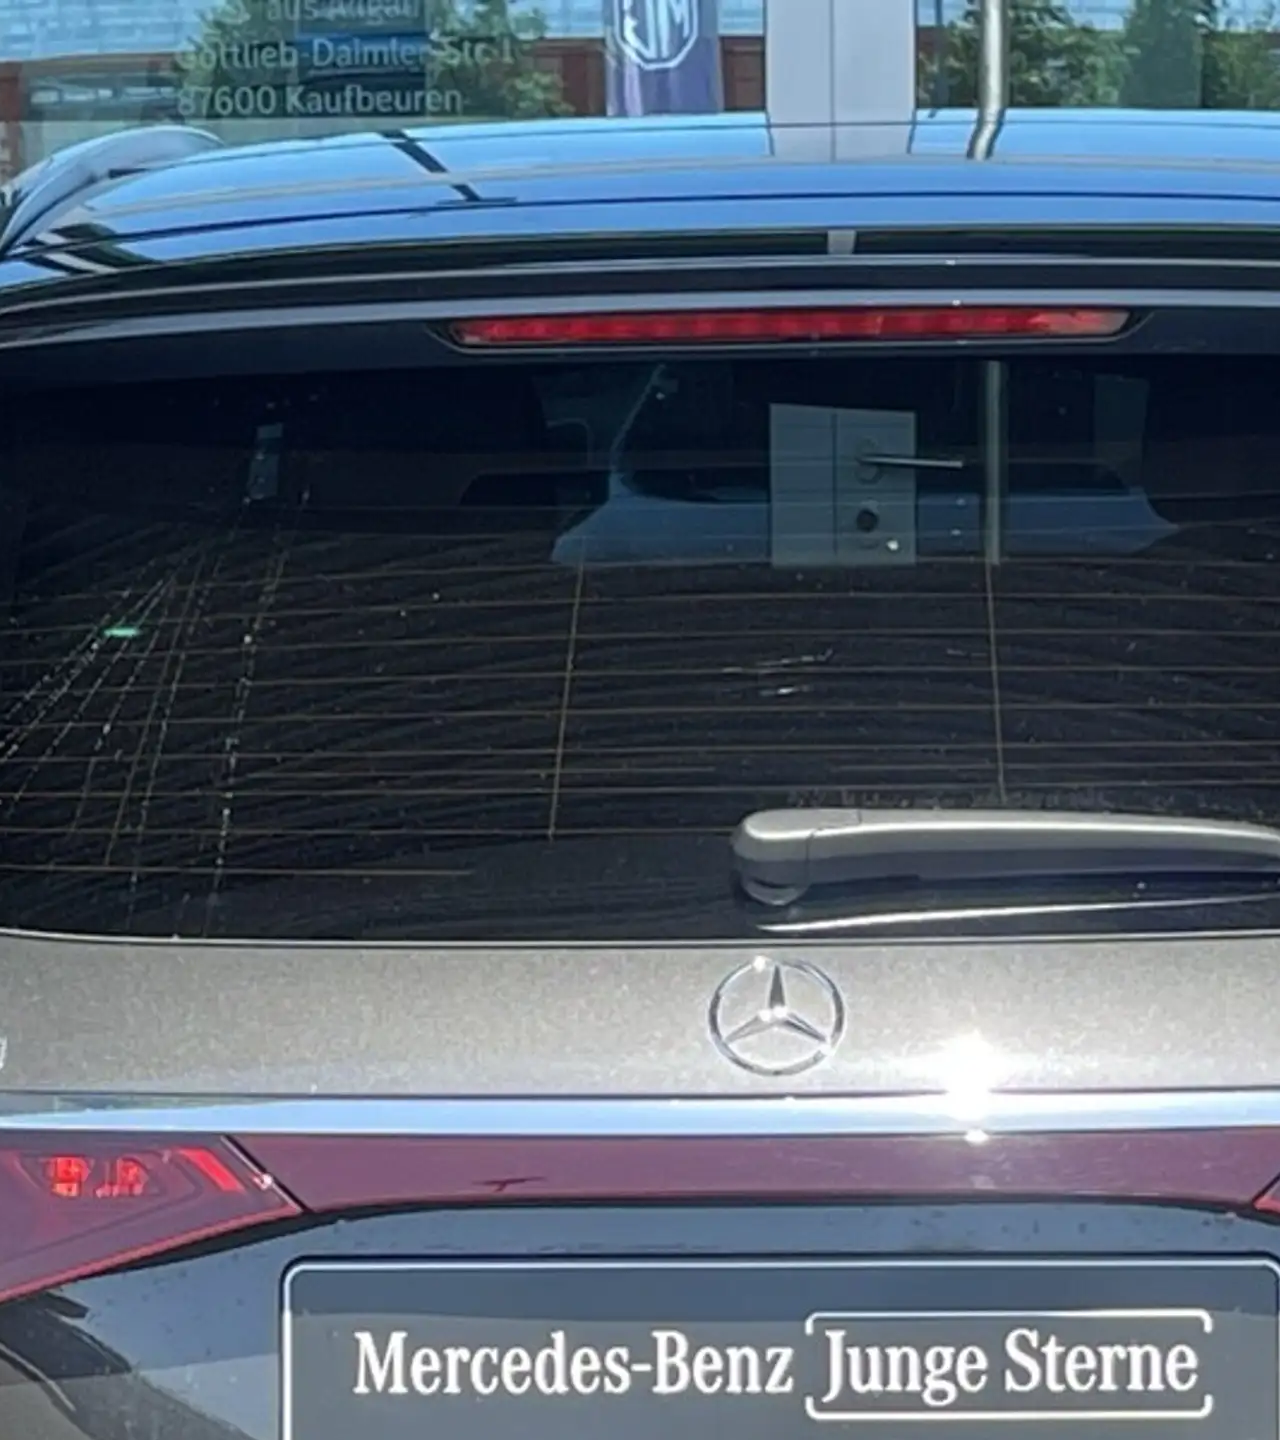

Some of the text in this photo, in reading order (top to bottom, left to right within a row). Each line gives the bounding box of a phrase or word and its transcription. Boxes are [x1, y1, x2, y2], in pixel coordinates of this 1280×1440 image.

[178, 82, 463, 116] 87600 Kaufbeuren
[353, 1329, 1200, 1405] Mercedes-Benz Junge Sterne
